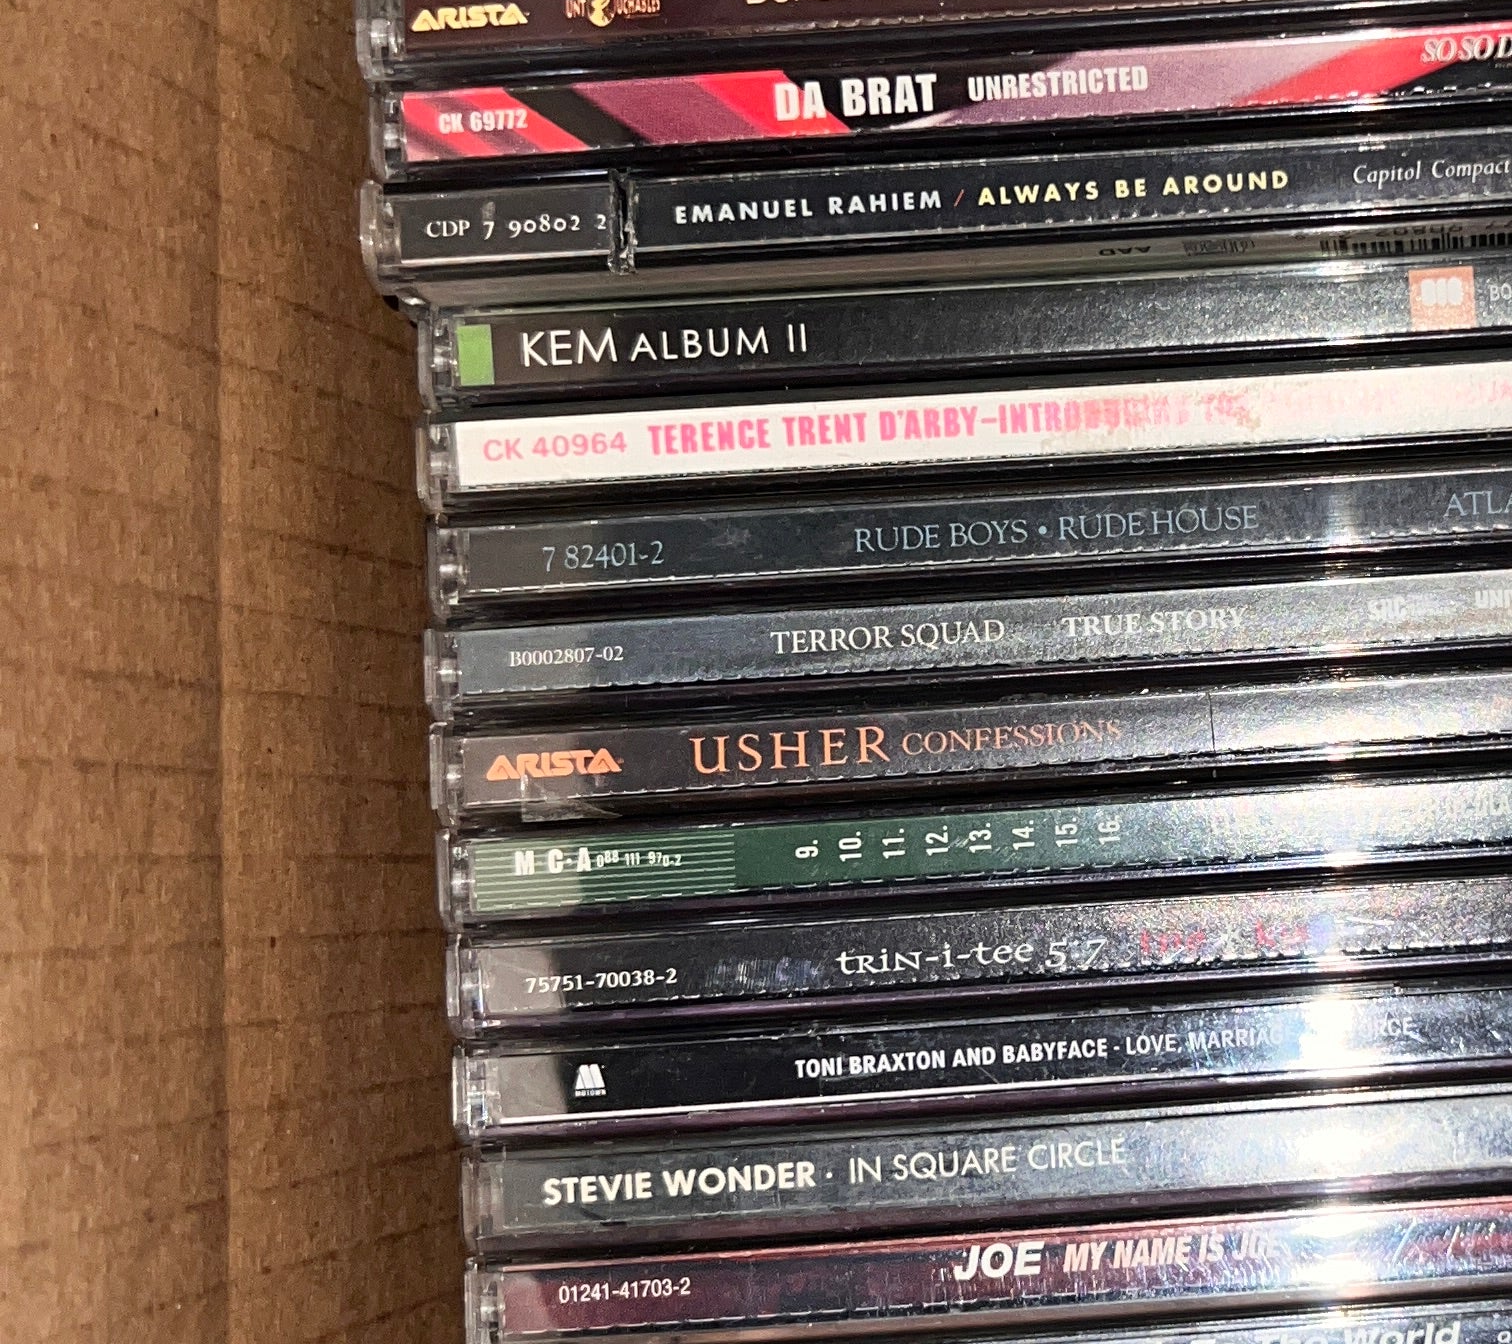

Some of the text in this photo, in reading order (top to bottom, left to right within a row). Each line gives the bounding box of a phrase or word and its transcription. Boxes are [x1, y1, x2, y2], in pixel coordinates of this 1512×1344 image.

[470, 65, 1148, 131] 69772 DA BRAT UNRESTRICTED
[508, 170, 1289, 238] 90802 EMANUEL RAHIEM ALWAYS BE AROUND
[522, 326, 768, 367] KEM ALBUM
[533, 413, 866, 458] 40964 TERENCE TRENT
[564, 507, 1257, 569] 82401-2 RUDE BOYS RUDE HOUSE
[509, 620, 1005, 667] B0002807-02 TERROR SQUAD
[487, 726, 891, 781] ARISTA USHER
[927, 822, 992, 856] 12. 13.
[525, 969, 677, 994] 75751-70038-2
[795, 1047, 995, 1079] TONI BRAXTON AND
[543, 1157, 881, 1206] STEVIE WONDER IN
[559, 1237, 1190, 1305] 01241-41703-2 JOE NAME
